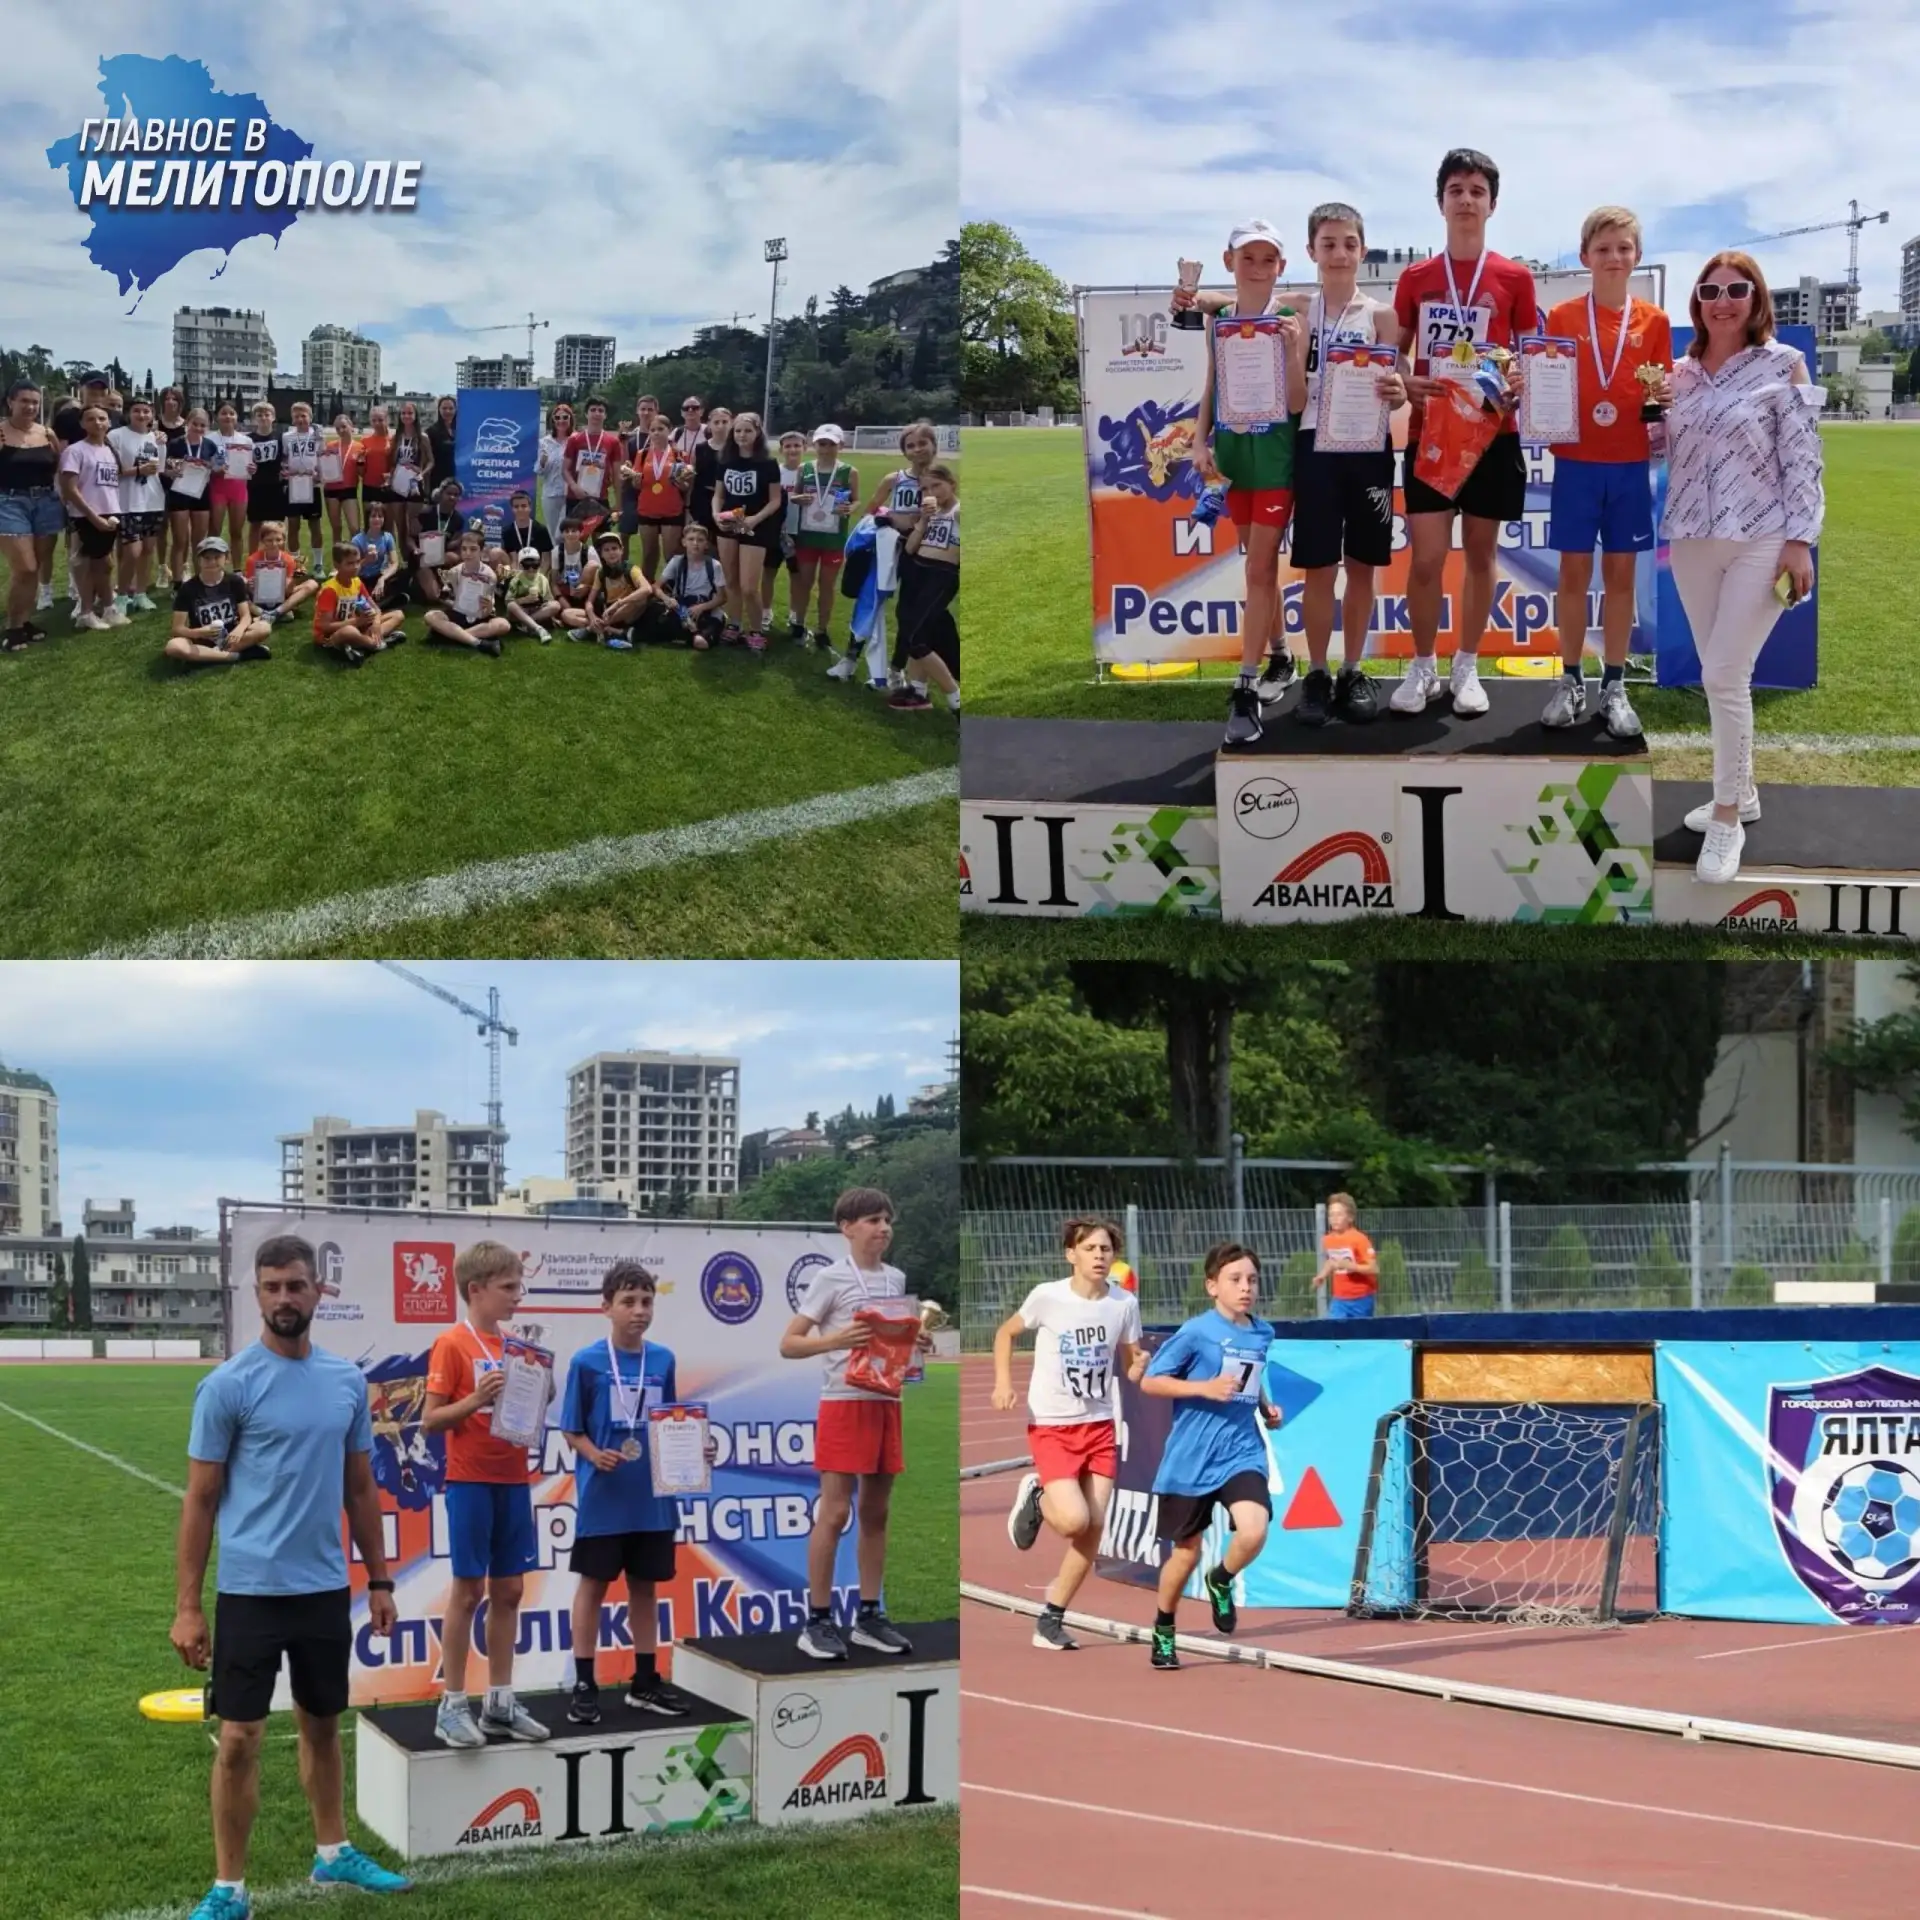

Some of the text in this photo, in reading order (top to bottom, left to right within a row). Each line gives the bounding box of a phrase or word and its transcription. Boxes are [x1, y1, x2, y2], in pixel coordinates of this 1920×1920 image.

[471, 458, 520, 469] КРЕПКАЯ
[476, 470, 513, 479] СЕМЬЯ
[726, 475, 754, 494] 505
[200, 602, 233, 625] 832
[1252, 884, 1395, 908] АВАНГАРД
[1715, 916, 1799, 933] АВАНГАРД
[402, 1300, 448, 1312] СПОРТА
[1075, 1325, 1107, 1346] ПРО
[1066, 1366, 1107, 1399] 511
[1781, 1399, 1853, 1409] ГОРОДСКОЙ
[782, 1778, 888, 1810] АВАНГАРД
[456, 1821, 543, 1846] АВАНГАРД
